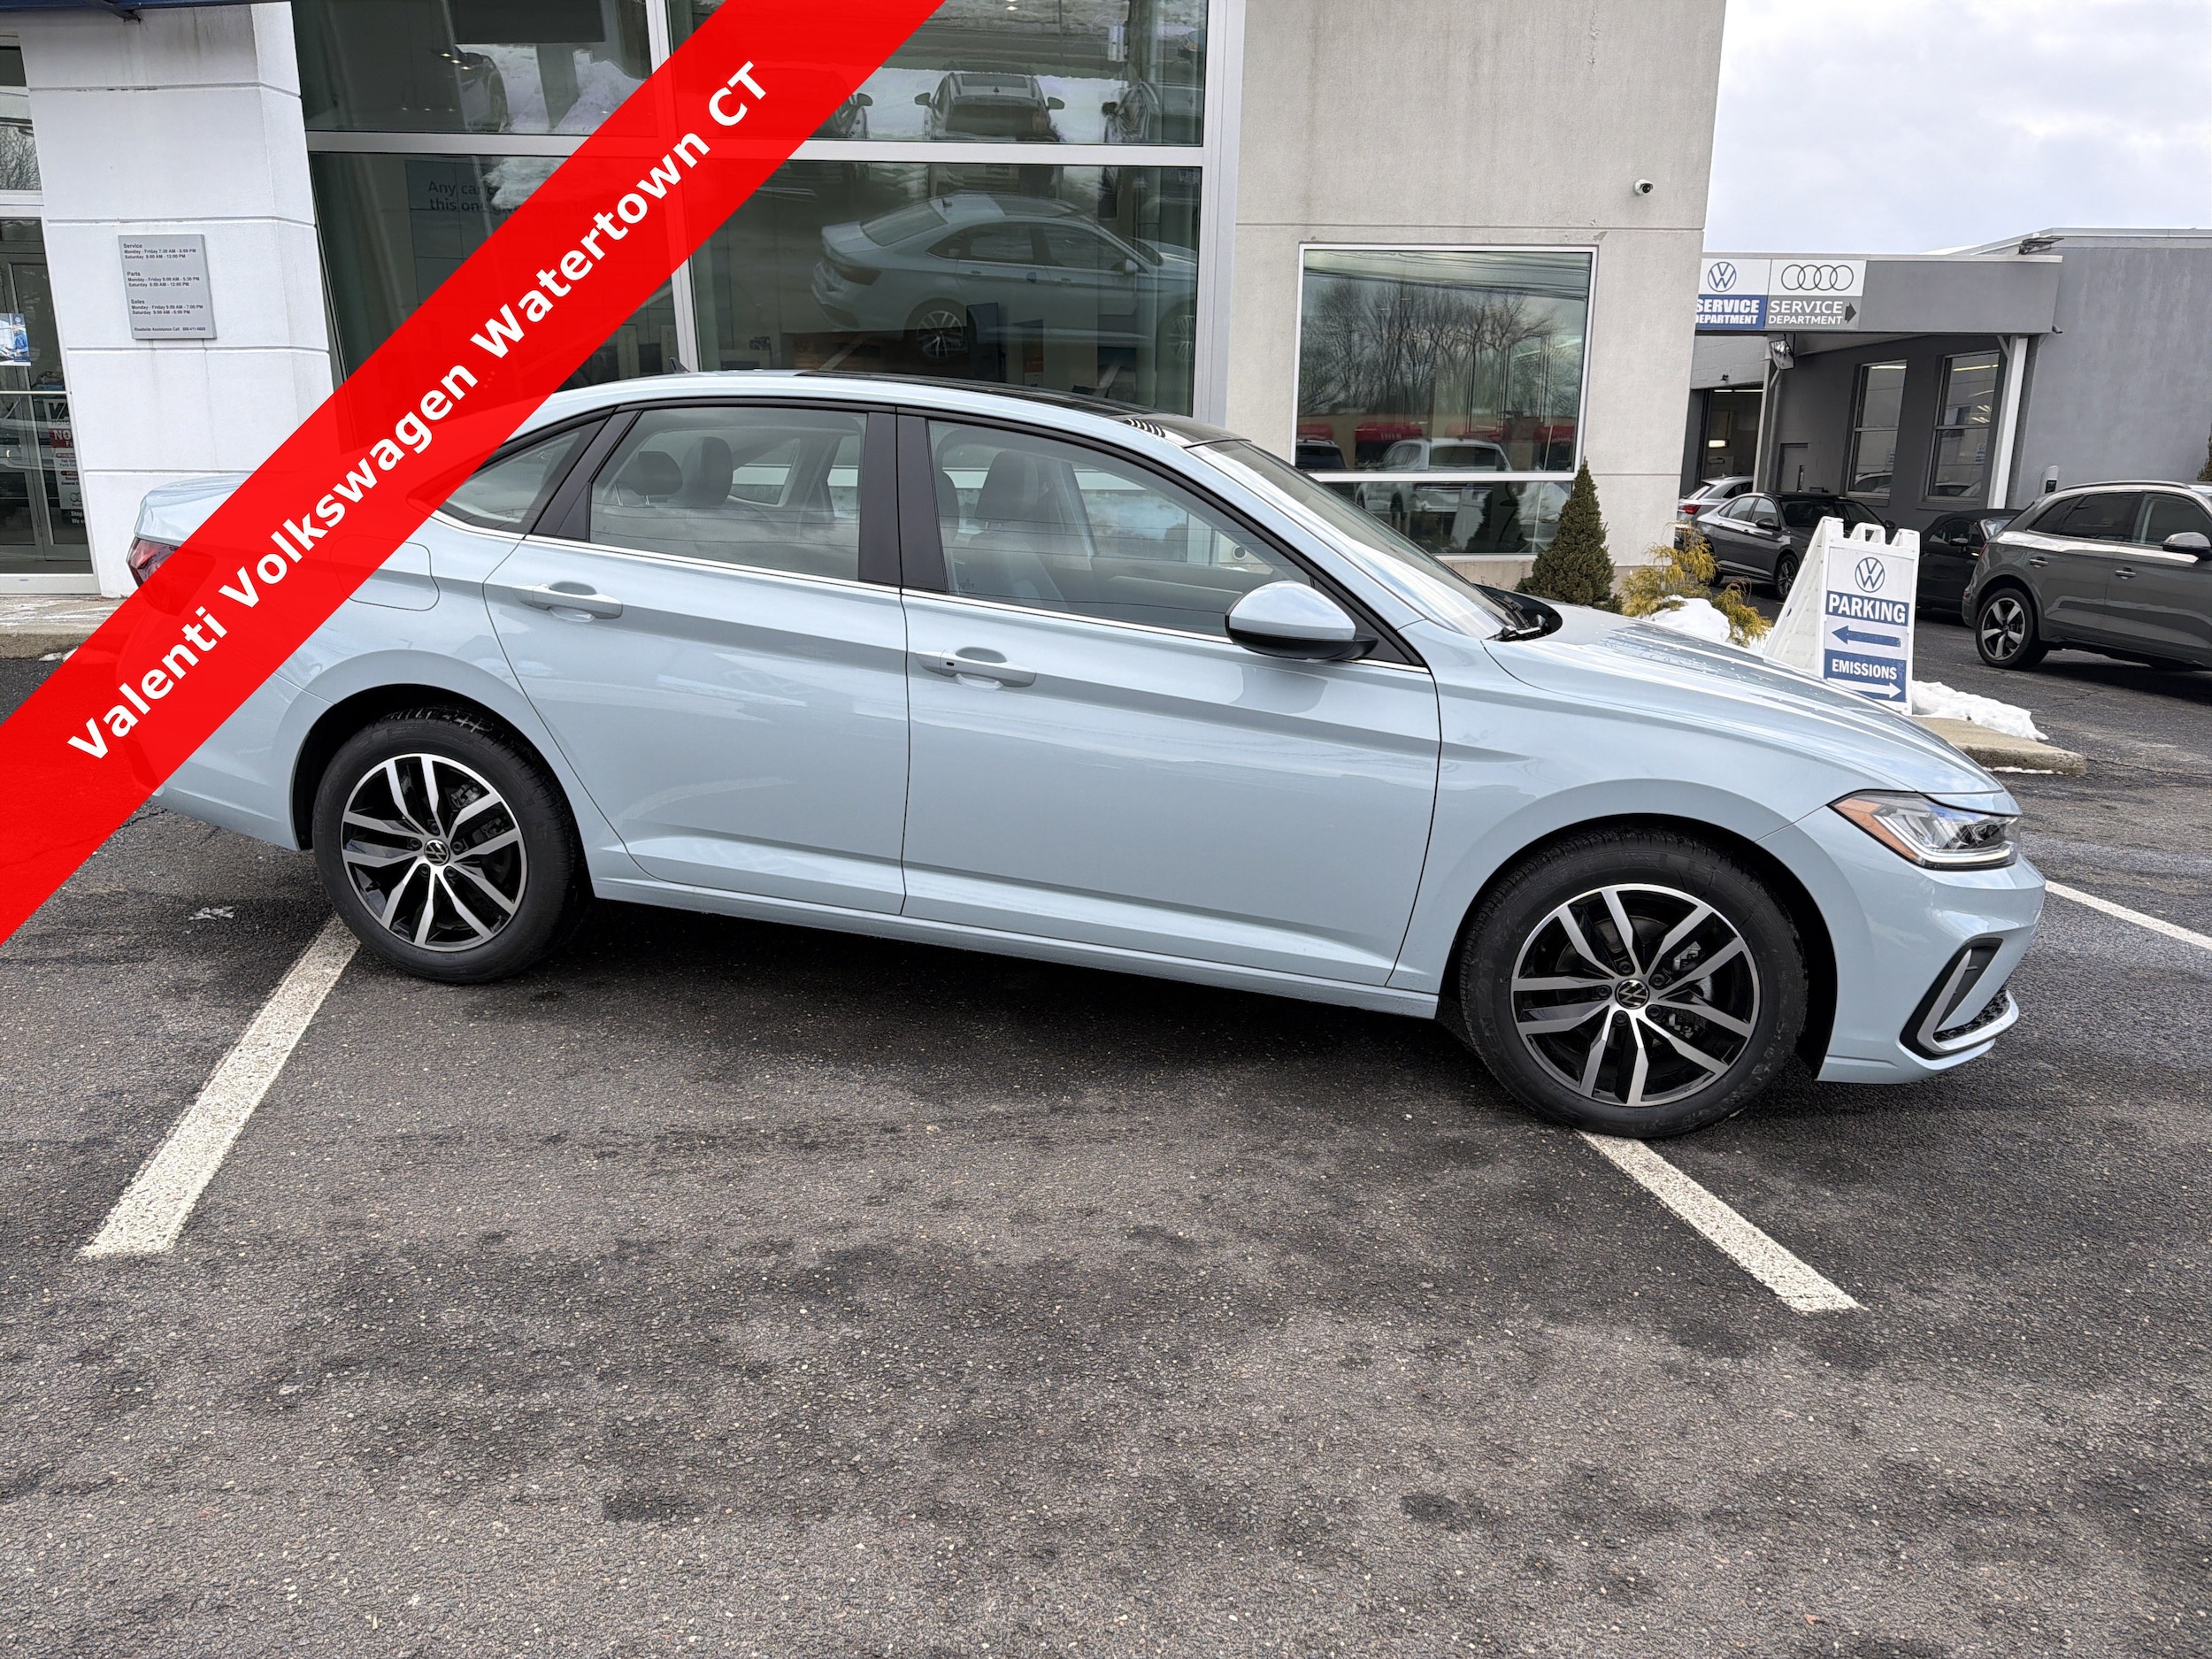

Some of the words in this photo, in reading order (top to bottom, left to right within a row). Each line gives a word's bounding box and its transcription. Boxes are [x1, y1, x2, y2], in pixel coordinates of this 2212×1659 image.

[427, 181, 456, 196] Any
[429, 198, 457, 211] this
[461, 202, 486, 211] on
[1697, 299, 1760, 313] SERVICE
[1770, 300, 1843, 313] SERVICE
[1769, 315, 1843, 325] DEPARTMENT
[1828, 594, 1906, 624] PARKING
[1832, 658, 1897, 680] EMISSIONS
